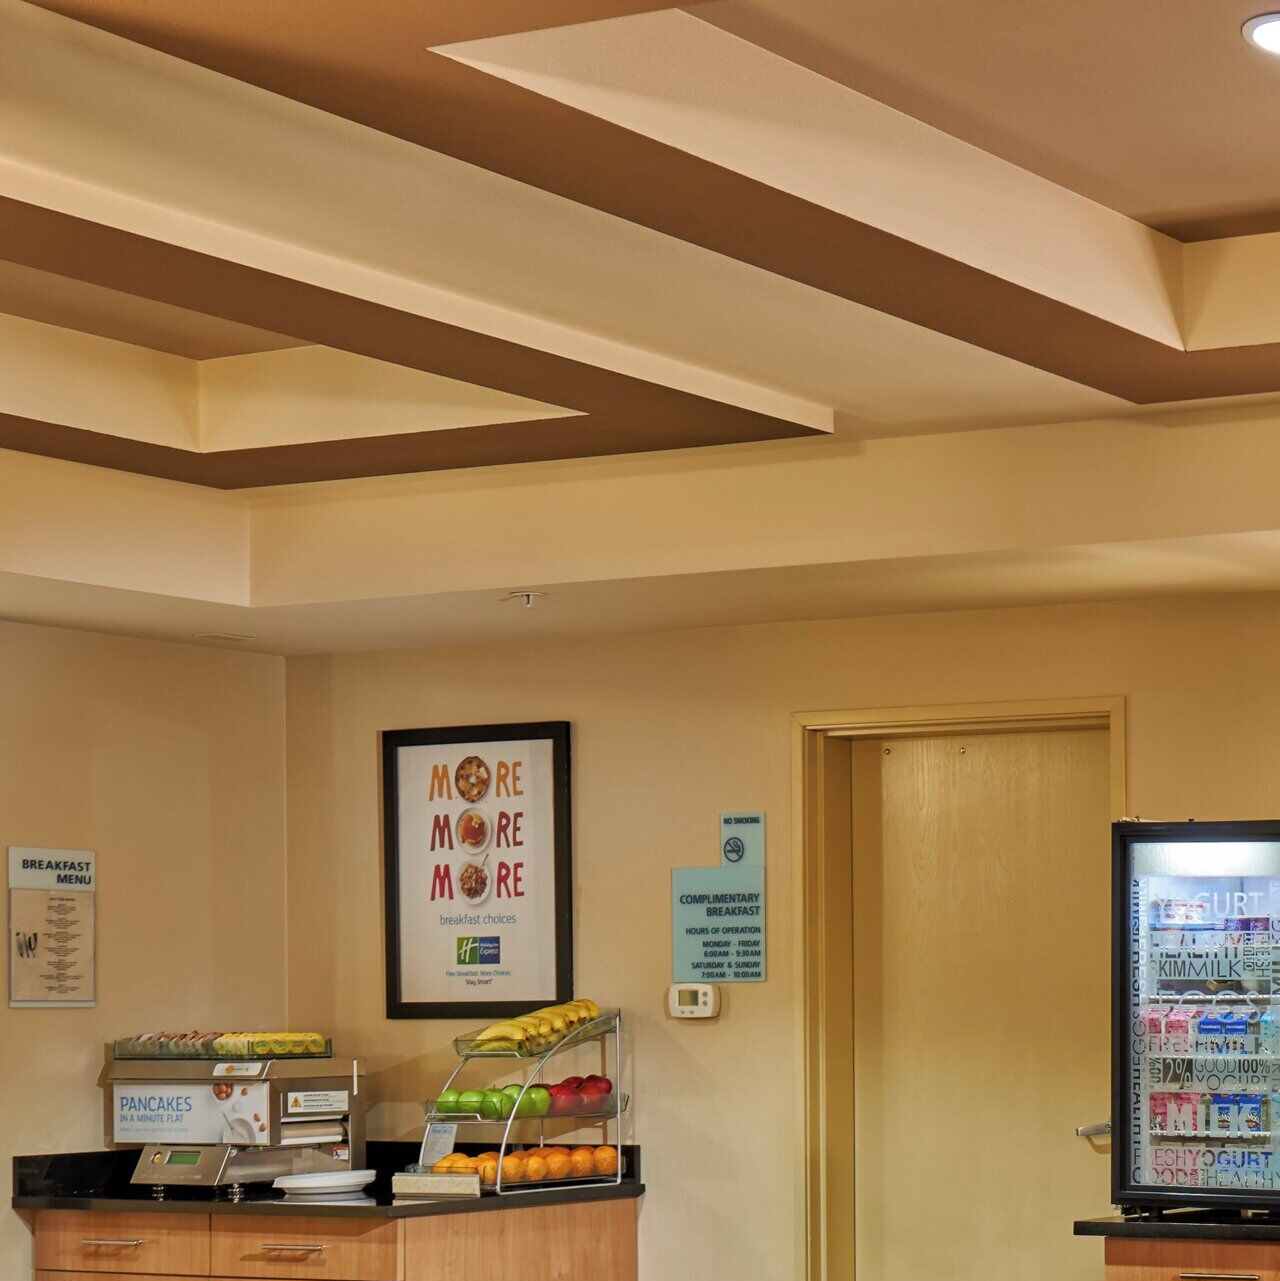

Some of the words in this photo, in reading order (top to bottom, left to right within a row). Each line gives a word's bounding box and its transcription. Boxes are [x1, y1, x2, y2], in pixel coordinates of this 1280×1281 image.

[22, 859, 91, 871] BREAKFAST
[57, 874, 91, 884] MENU
[680, 893, 759, 904] COMPLIMENTARY
[1153, 891, 1264, 917] YOGURT
[707, 906, 760, 916] BREAKFAST
[440, 914, 480, 925] breakfast
[483, 914, 516, 924] choices
[1165, 1058, 1194, 1090] 2%
[120, 1097, 192, 1112] PANCAKES
[120, 1114, 127, 1123] IN
[130, 1114, 134, 1122] A
[137, 1114, 164, 1123] MINUTE
[167, 1114, 184, 1123] FLAT
[1166, 1100, 1251, 1138] MILK
